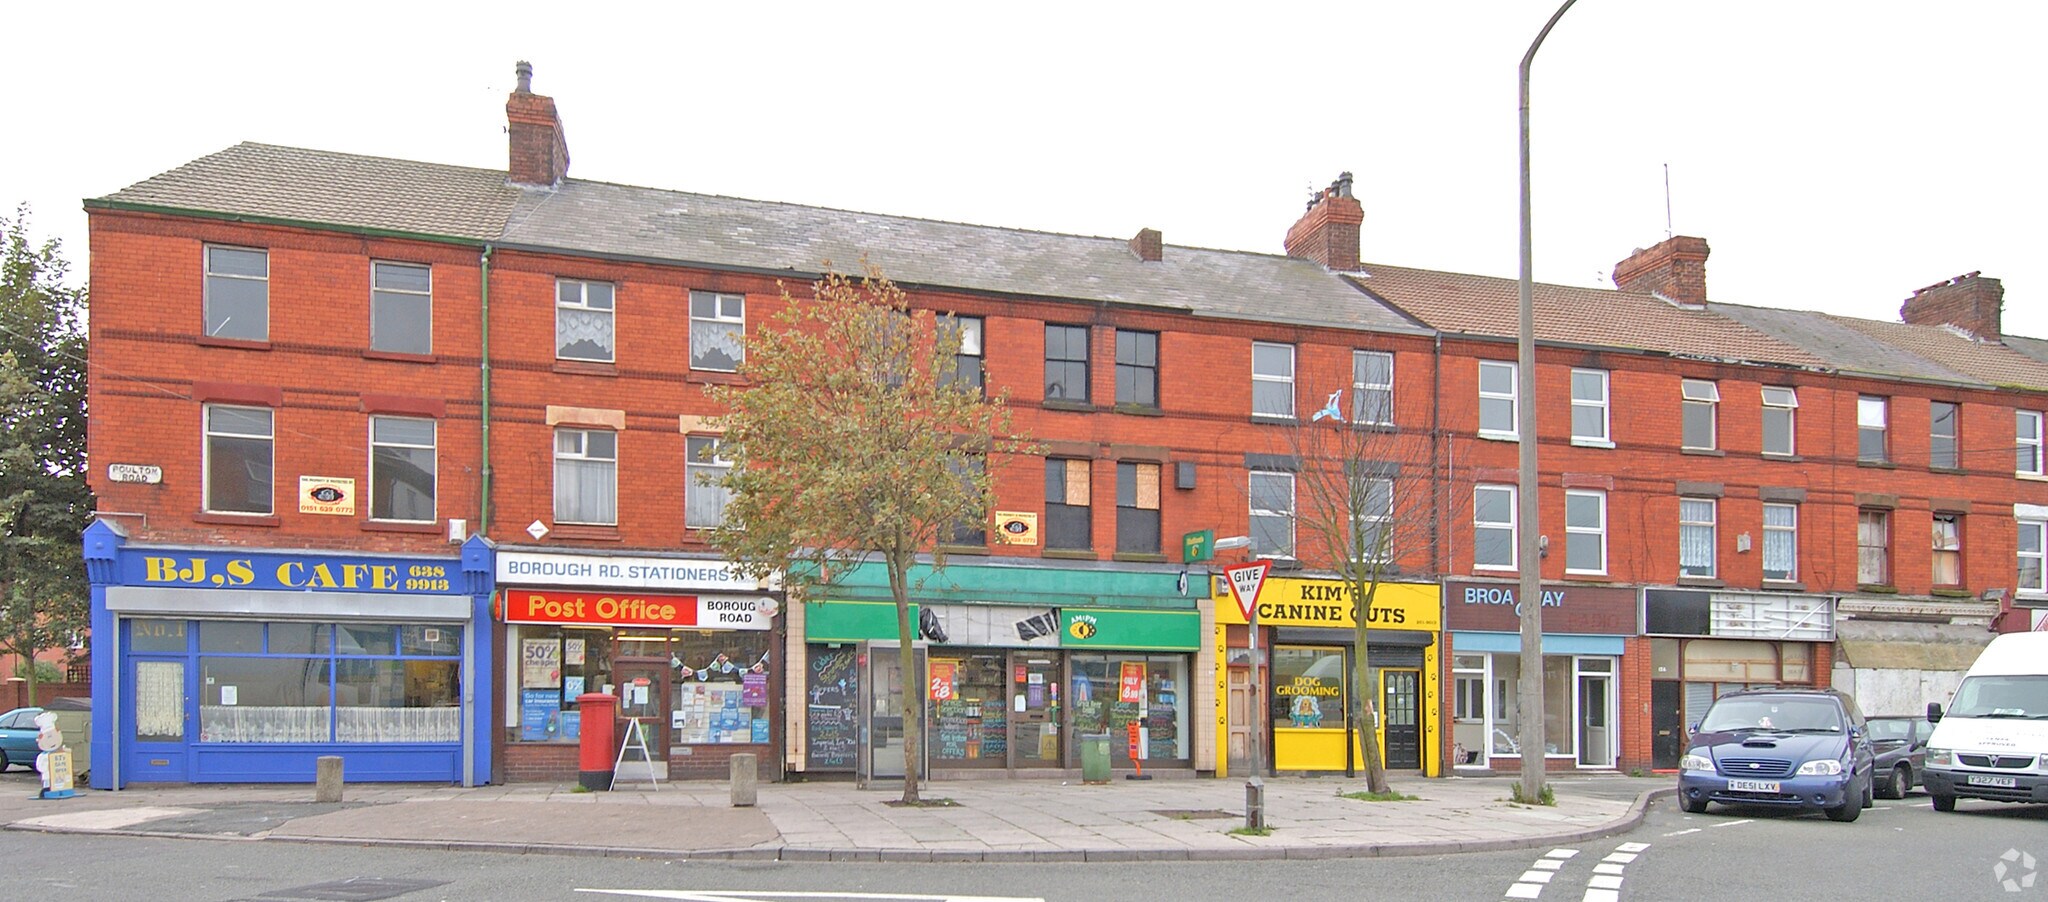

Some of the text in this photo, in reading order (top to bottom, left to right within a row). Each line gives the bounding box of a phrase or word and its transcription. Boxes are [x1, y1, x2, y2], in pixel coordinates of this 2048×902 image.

[112, 465, 158, 475] POULTON
[122, 474, 148, 482] ROAD
[276, 562, 399, 590] CAFE
[409, 565, 446, 578] 638
[508, 561, 592, 576] BOROUGH
[599, 565, 624, 578] RD.
[628, 566, 729, 582] STATIONERS
[1234, 568, 1259, 582] GIVE
[406, 579, 450, 591] 9913
[1240, 584, 1256, 592] WAY
[1464, 588, 1564, 607] BROAAY
[528, 595, 586, 618] Post
[596, 598, 676, 620] Office
[707, 601, 756, 612] BOROUG
[1258, 604, 1342, 621] CANINE
[720, 613, 752, 623] ROAD
[526, 646, 557, 659] 50%
[931, 678, 941, 690] 2
[1294, 676, 1320, 687] DOG
[1276, 686, 1339, 696] GROOMING
